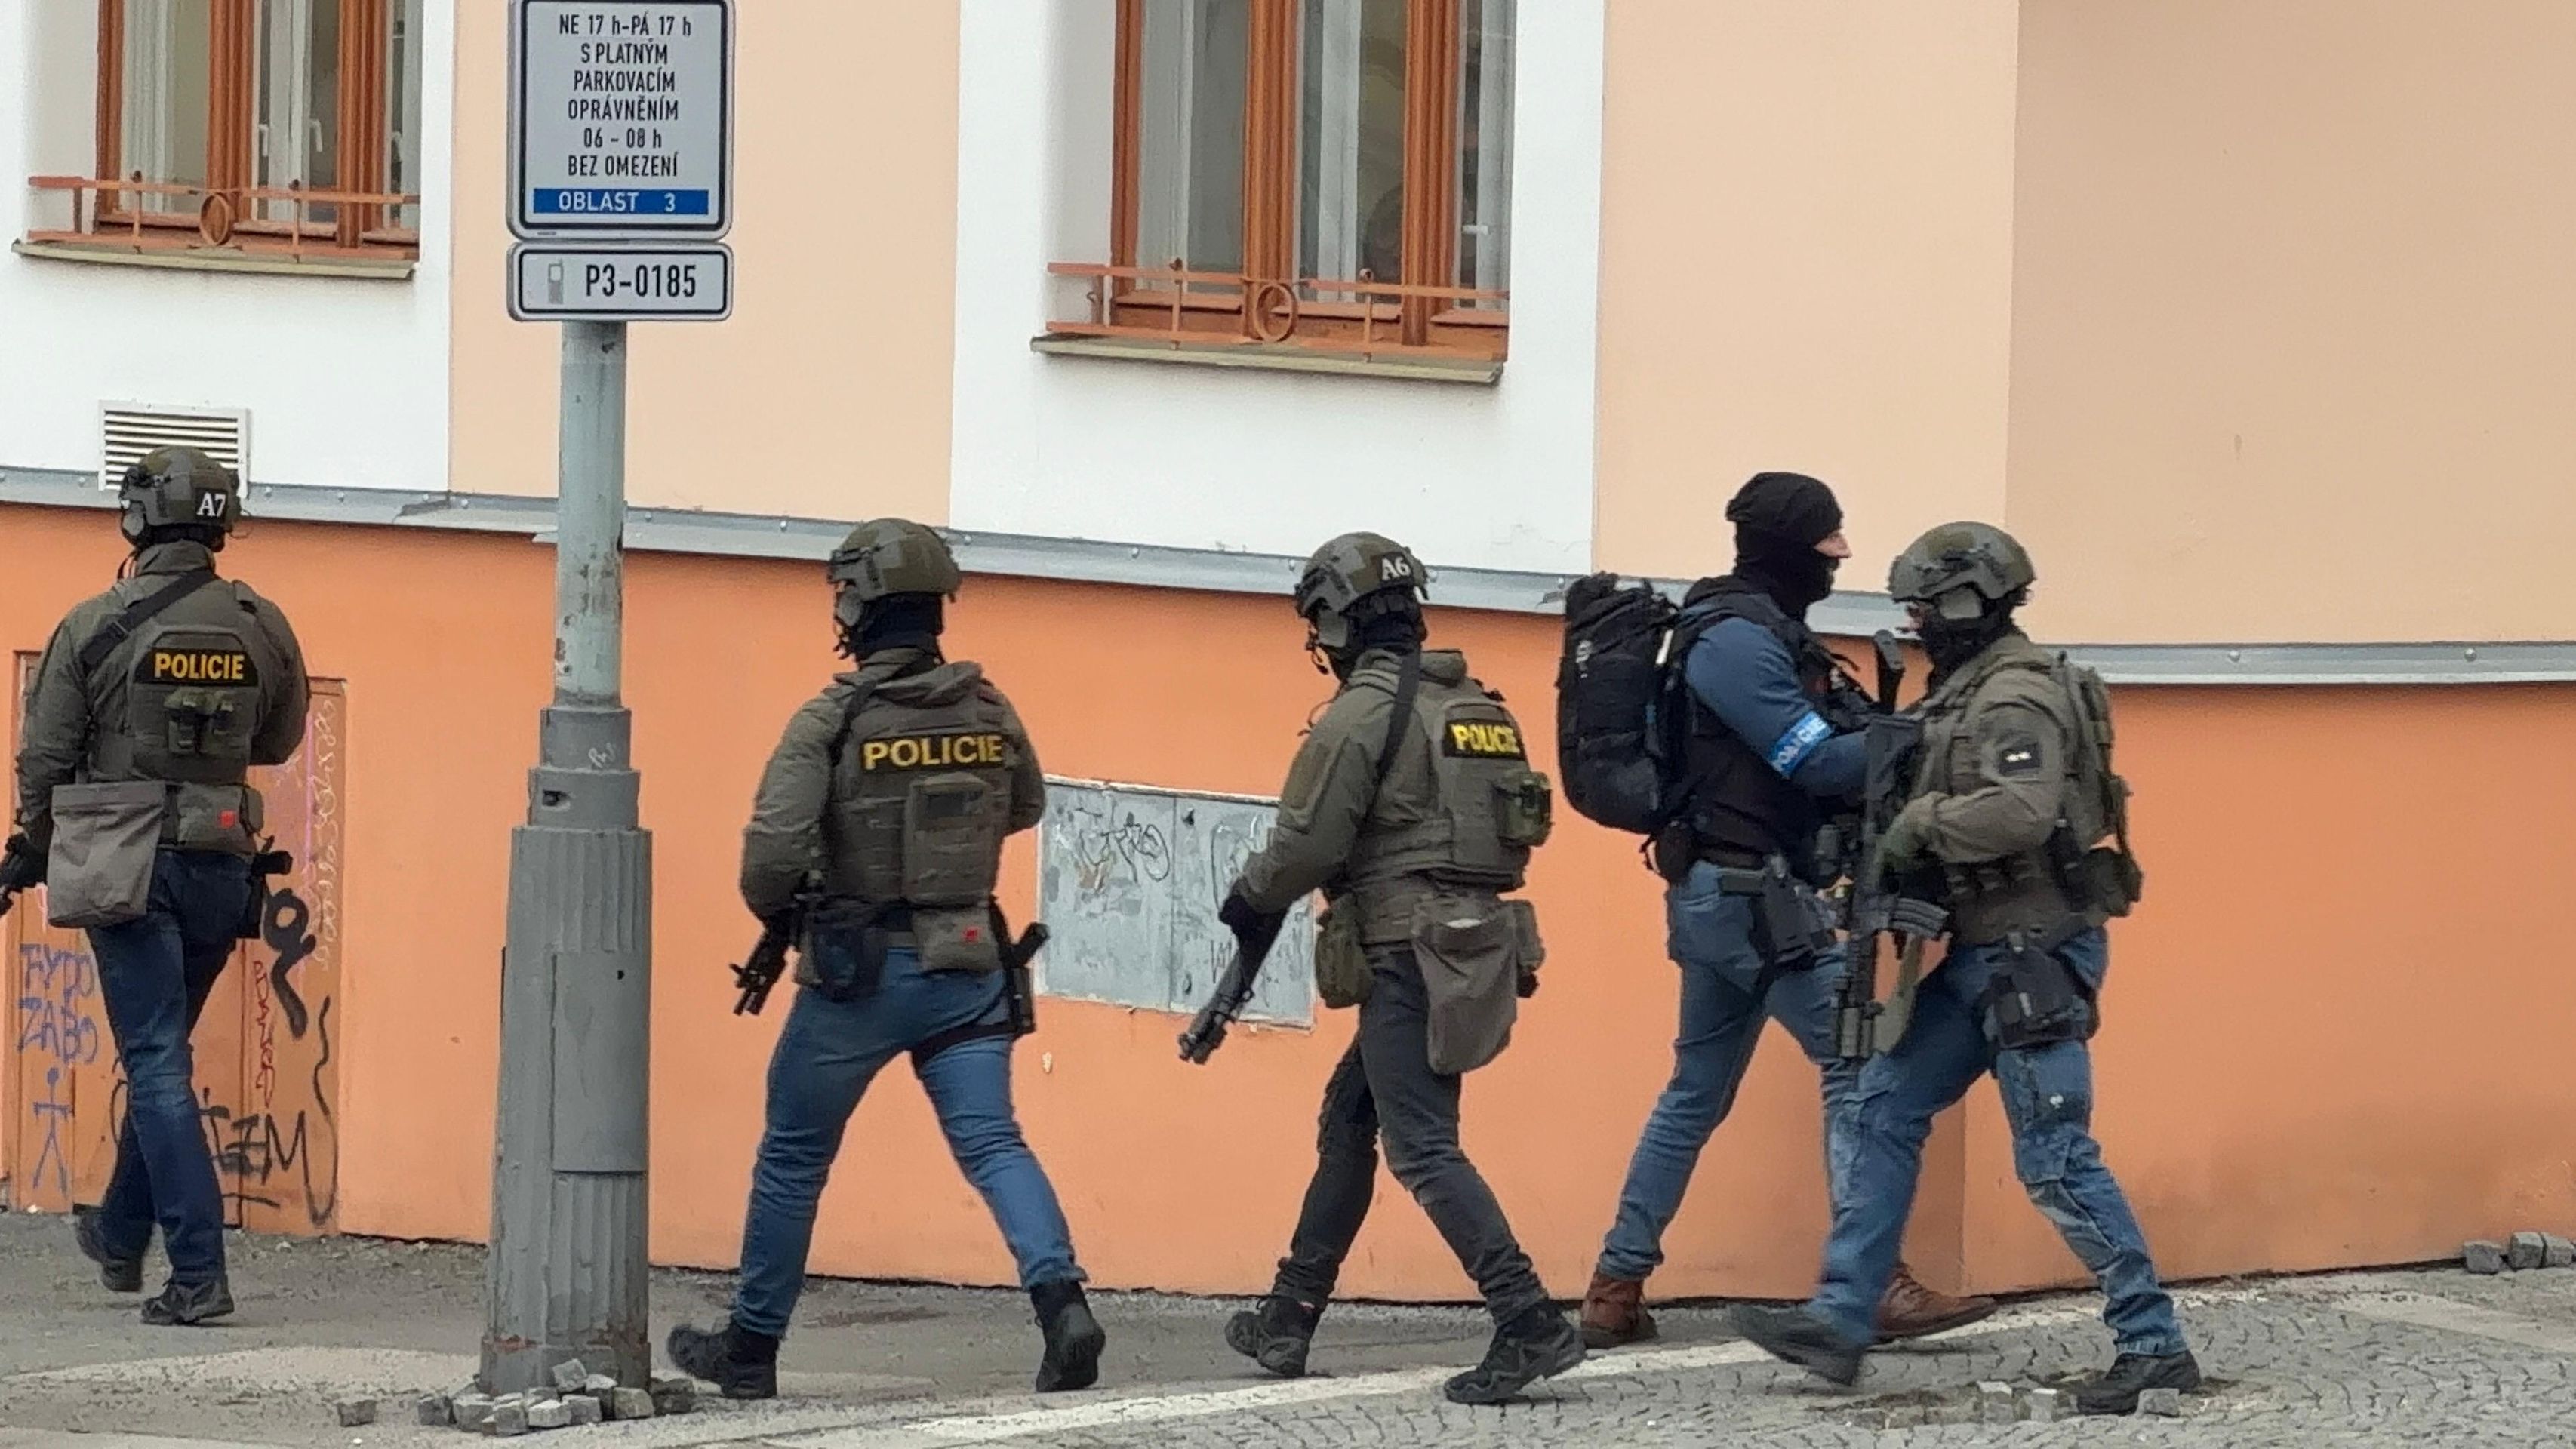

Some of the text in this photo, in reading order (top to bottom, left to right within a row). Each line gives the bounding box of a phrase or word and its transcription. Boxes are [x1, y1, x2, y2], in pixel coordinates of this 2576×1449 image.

[559, 14, 580, 35] NE
[589, 14, 605, 35] 17
[659, 15, 676, 36] 17
[682, 16, 692, 36] h
[581, 38, 668, 65] S PLATNÝM
[574, 66, 676, 92] PARKOVACÍM
[568, 92, 679, 121] OPRÁVNĚNÍM
[583, 127, 603, 148] 06
[626, 127, 646, 149] 08
[653, 128, 663, 149] h
[568, 151, 679, 177] BEZ OMEZENÍ
[558, 191, 676, 212] OBLAST 3
[585, 263, 697, 298] P3-0185
[196, 491, 226, 518] A7
[1381, 556, 1411, 582] A6
[154, 653, 245, 680] POLICIE
[863, 734, 1002, 770] POLICIE
